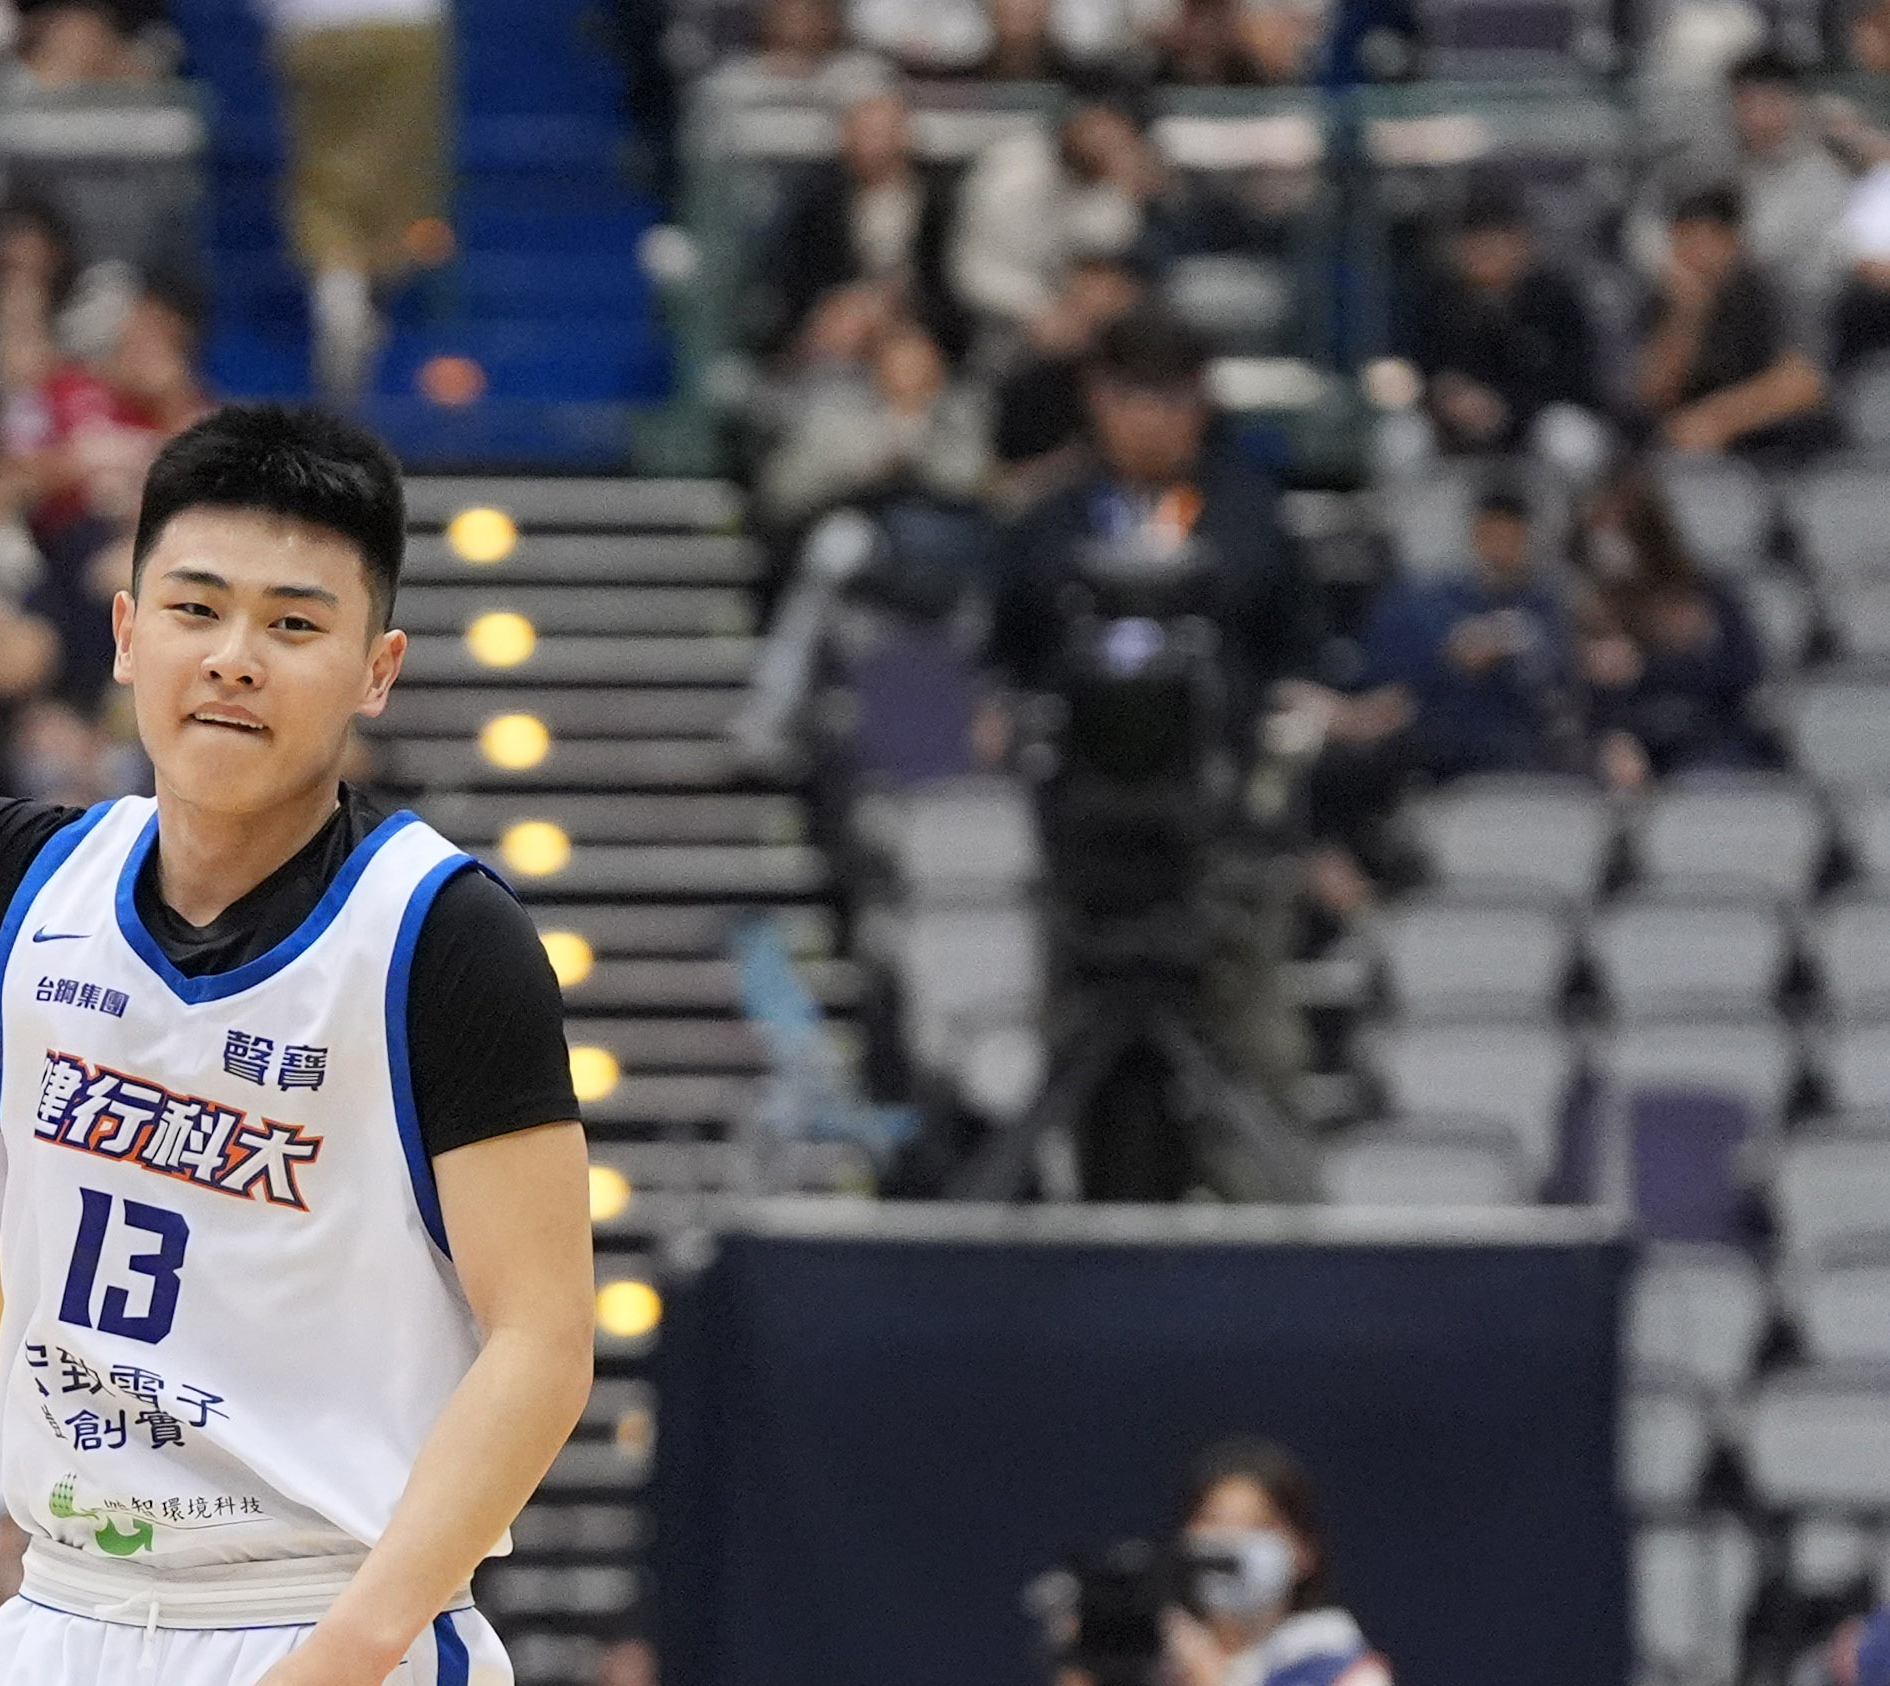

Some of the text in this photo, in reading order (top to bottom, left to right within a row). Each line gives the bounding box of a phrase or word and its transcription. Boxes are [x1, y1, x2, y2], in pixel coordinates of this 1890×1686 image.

[36, 976, 130, 1018] 台鋼集團
[223, 1029, 328, 1092] 聲寶
[57, 1187, 190, 1345] 13
[41, 1404, 186, 1451] 創實
[104, 1496, 264, 1522] 智環境科技
